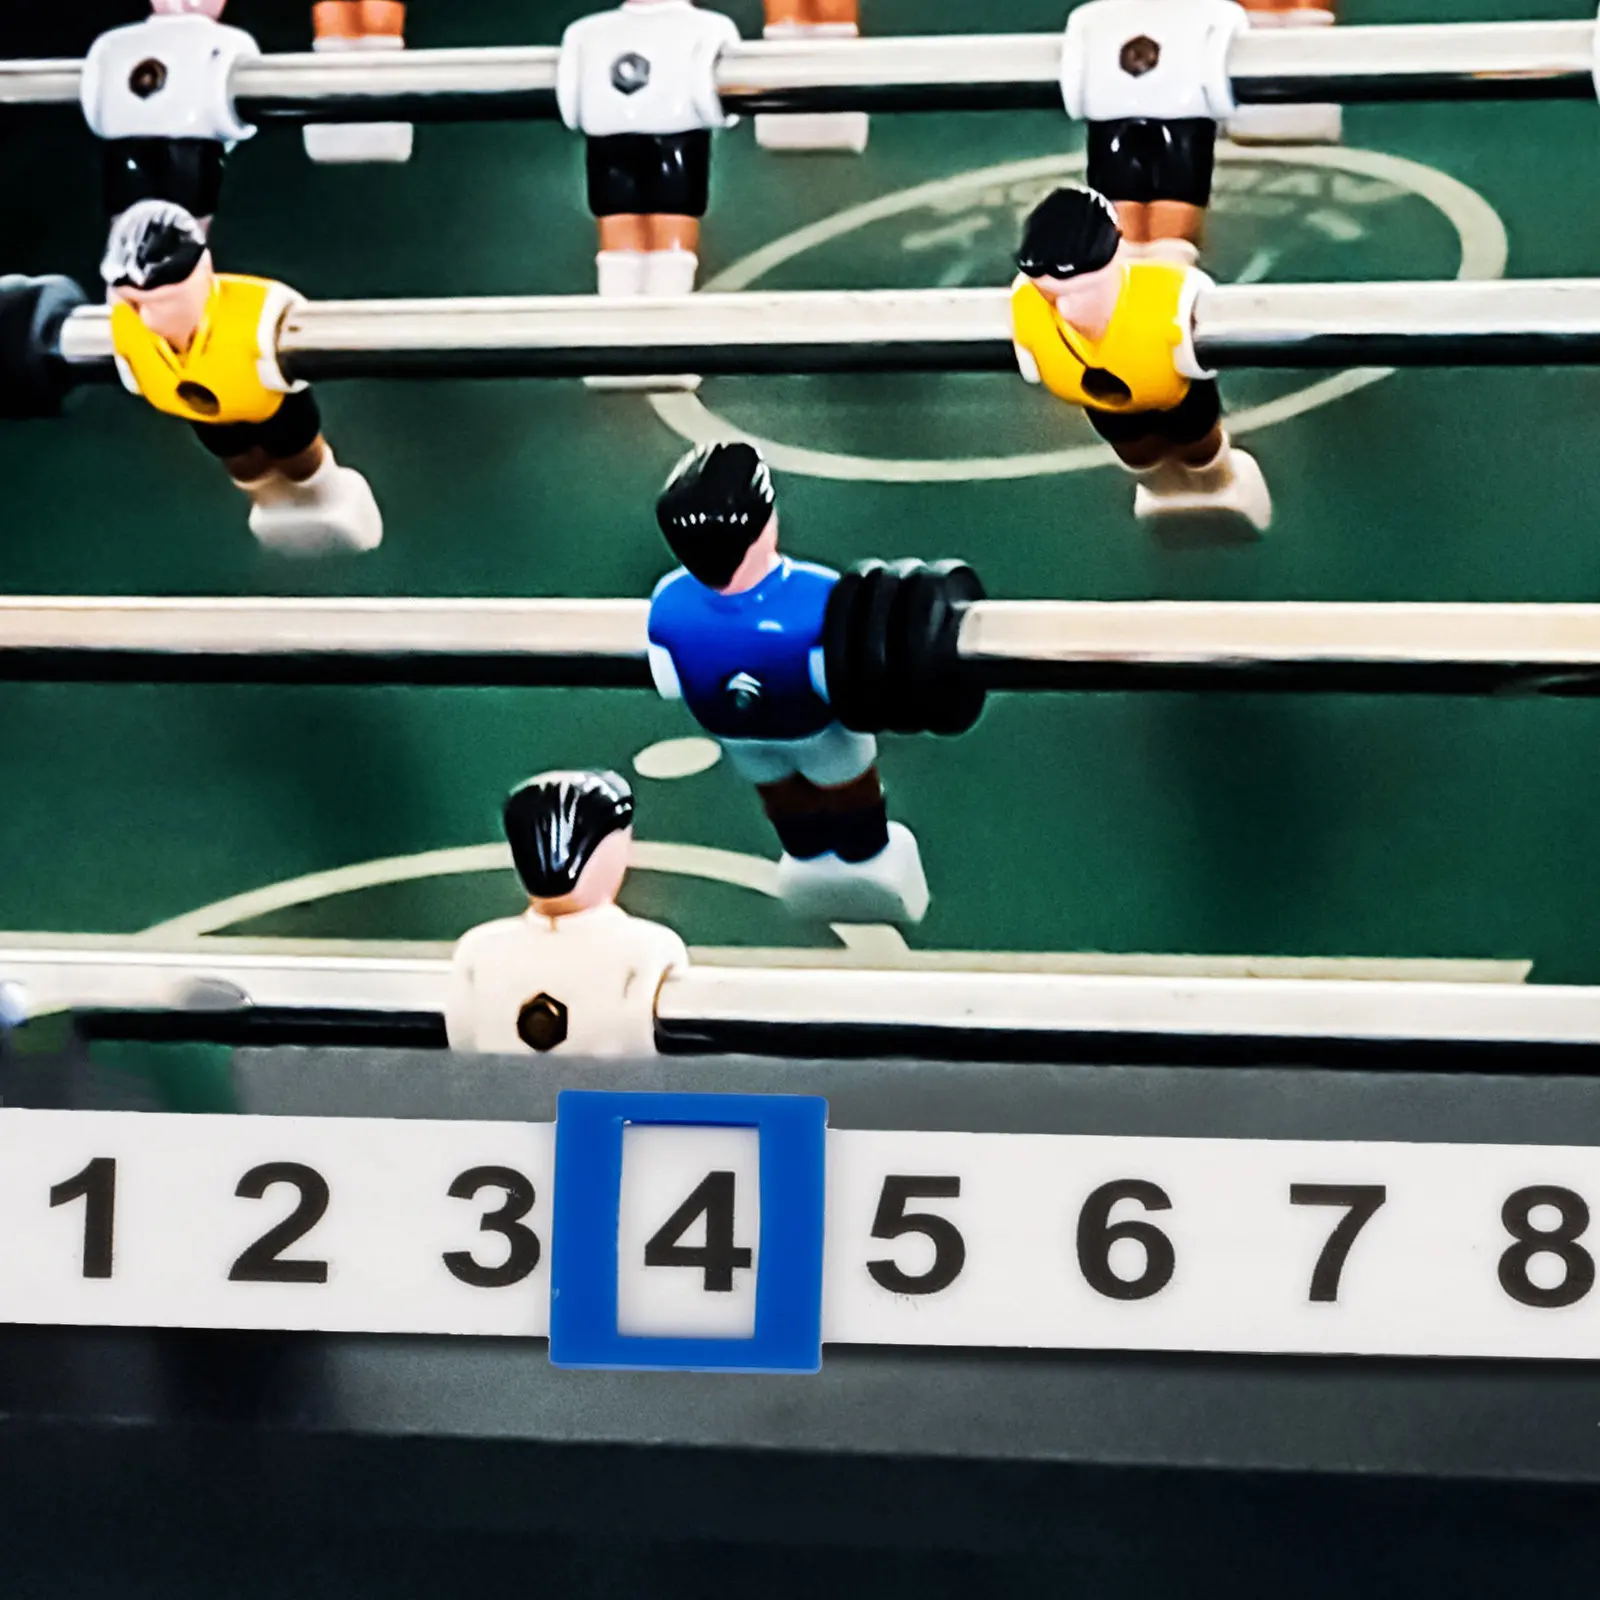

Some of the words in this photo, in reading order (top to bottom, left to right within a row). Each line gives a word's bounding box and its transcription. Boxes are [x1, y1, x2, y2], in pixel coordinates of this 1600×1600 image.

[50, 1158, 115, 1278] 1
[228, 1162, 329, 1283] 2
[442, 1166, 540, 1287] 3
[645, 1171, 752, 1292] 4
[867, 1175, 965, 1294] 5
[1077, 1179, 1175, 1300] 6
[1290, 1184, 1386, 1302] 7
[1498, 1186, 1595, 1308] 8
